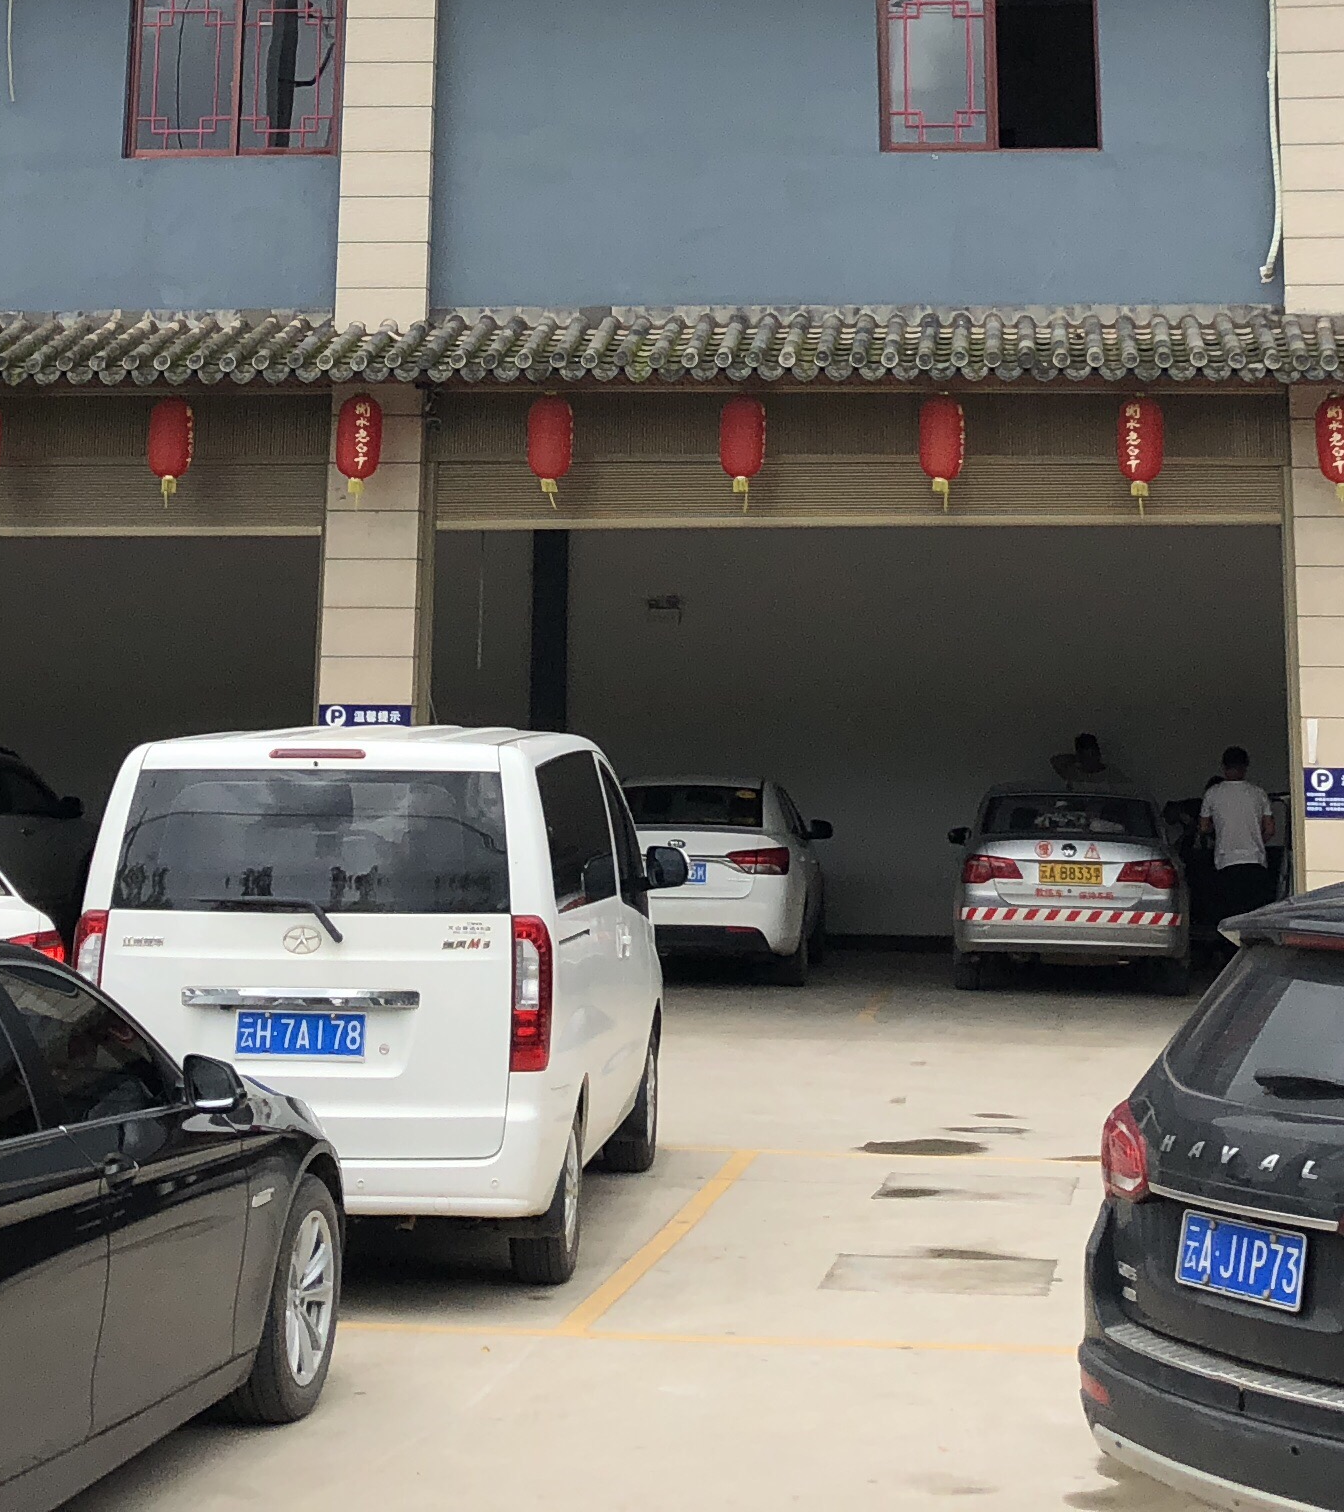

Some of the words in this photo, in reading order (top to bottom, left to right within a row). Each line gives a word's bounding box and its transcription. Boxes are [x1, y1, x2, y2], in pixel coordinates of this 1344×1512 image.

[1125, 403, 1142, 473] 衡水老白干
[1160, 1135, 1318, 1179] HAVAL
